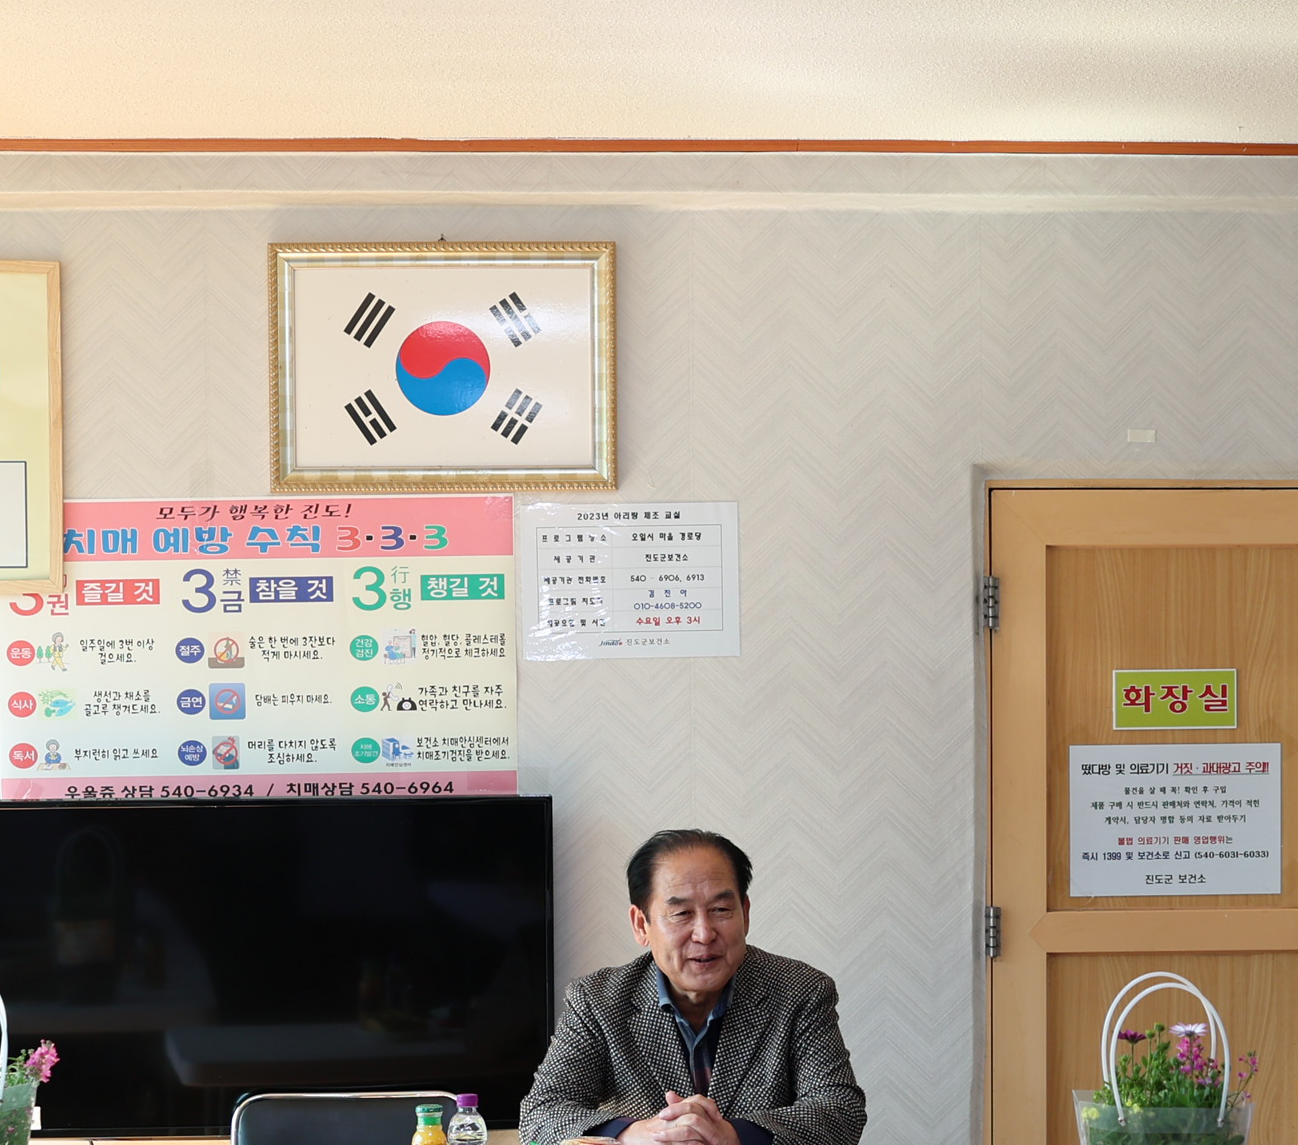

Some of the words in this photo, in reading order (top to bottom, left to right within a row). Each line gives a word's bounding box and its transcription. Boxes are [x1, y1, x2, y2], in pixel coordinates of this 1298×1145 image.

[156, 504, 220, 522] 모두가
[229, 504, 294, 521] 행복한
[300, 503, 352, 521] 진도!
[577, 512, 609, 521] 2023년
[63, 527, 139, 555] 치매
[151, 525, 233, 555] 예방
[245, 525, 321, 554] 수칙
[645, 553, 689, 562] 진도군보건소
[222, 568, 241, 585] 禁
[390, 566, 410, 584] 行
[630, 575, 647, 583] 540
[686, 574, 705, 582] 6913
[81, 582, 125, 603] 즐길
[133, 582, 154, 602] 것
[181, 568, 217, 614] 3
[219, 590, 245, 613] 금
[255, 579, 299, 600] 참을
[307, 578, 327, 600] 것
[352, 566, 387, 611] 3
[390, 588, 411, 611] 행
[427, 577, 469, 598] 챙길
[478, 576, 499, 598] 것
[634, 602, 702, 610] 010-4608-5200
[635, 616, 661, 626] 수요일
[665, 616, 682, 625] 오후
[686, 616, 701, 625] 3시
[79, 639, 116, 651] 일주일에
[119, 639, 134, 651] 3번
[136, 638, 155, 651] 이상
[268, 636, 278, 649] 한
[280, 636, 299, 649] 번에
[302, 636, 336, 648] 3잔보다
[355, 638, 373, 648] 건강
[464, 633, 507, 646] 콜레스테롤
[626, 638, 670, 647] 진도군보건소
[9, 647, 33, 660] 운동
[179, 645, 202, 657] 절주
[261, 650, 281, 662] 적게
[283, 649, 323, 661] 마시세요.
[355, 648, 373, 658] 검진
[422, 648, 462, 661] 정기적으로
[98, 653, 137, 666] 걸으세요.
[93, 690, 121, 703] 생선과
[124, 690, 151, 703] 채소를
[418, 686, 448, 698] 가족과
[451, 685, 480, 698] 친구를
[483, 685, 504, 696] 자주
[11, 699, 33, 711] 식사
[180, 697, 203, 708] 금연
[255, 694, 279, 706] 담배는
[281, 694, 304, 706] 피우지
[354, 694, 377, 705] 소통
[418, 699, 459, 712] 연락하고
[462, 698, 507, 711] 만나세요.
[1122, 684, 1230, 713] 화장실
[84, 704, 108, 717] 골고루
[248, 739, 275, 752] 머리를
[278, 739, 307, 750] 다치지
[309, 738, 337, 752] 않도록
[416, 737, 440, 749] 보건소
[441, 736, 509, 749] 치매안심센터에서
[12, 750, 35, 762] 독서
[74, 749, 110, 761] 부지런히
[112, 749, 130, 761] 읽고
[132, 749, 159, 760] 쓰세요
[267, 752, 317, 765] 조심하세요.
[417, 749, 473, 762] 치매조기검진을
[1115, 763, 1126, 775] 및
[1129, 763, 1169, 775] 의료기기
[1173, 762, 1193, 775] 거짓
[1202, 762, 1241, 774] 과대광고
[120, 785, 155, 799] 상담
[160, 784, 254, 798] 540-6934
[286, 782, 354, 797] 치매상담
[360, 781, 454, 796] 540-6964
[1137, 801, 1159, 809] 반드시
[1137, 836, 1169, 845] 의료기기
[1082, 852, 1098, 861] 즉시
[1102, 852, 1122, 860] 1399
[1125, 851, 1134, 861] 및
[1137, 851, 1170, 860] 보건소로
[1174, 850, 1191, 860] 신고
[1145, 874, 1173, 885] 진도군
[1178, 873, 1206, 884] 보건소
